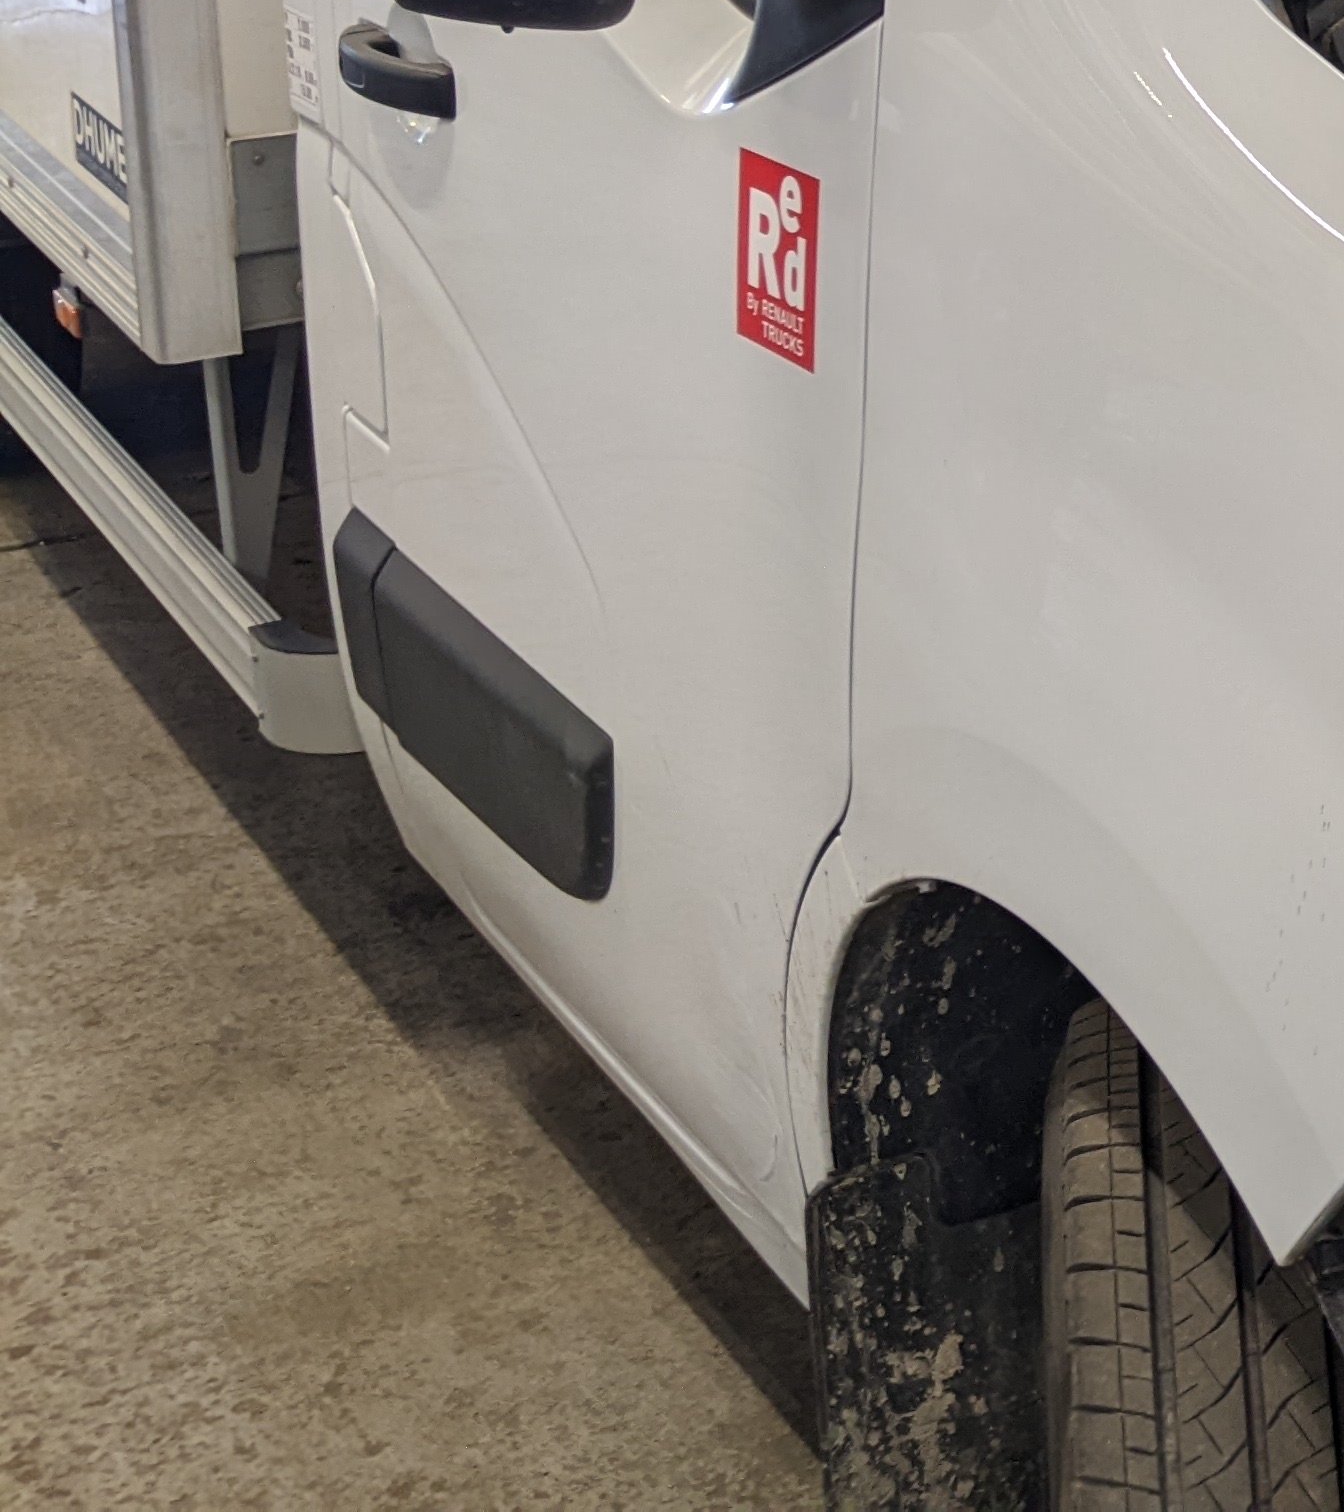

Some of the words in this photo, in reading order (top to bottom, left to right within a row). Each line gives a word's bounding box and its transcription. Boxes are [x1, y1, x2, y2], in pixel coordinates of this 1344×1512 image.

[747, 292, 759, 316] By
[762, 299, 804, 335] RENAULT
[761, 321, 804, 357] TRUCKS
